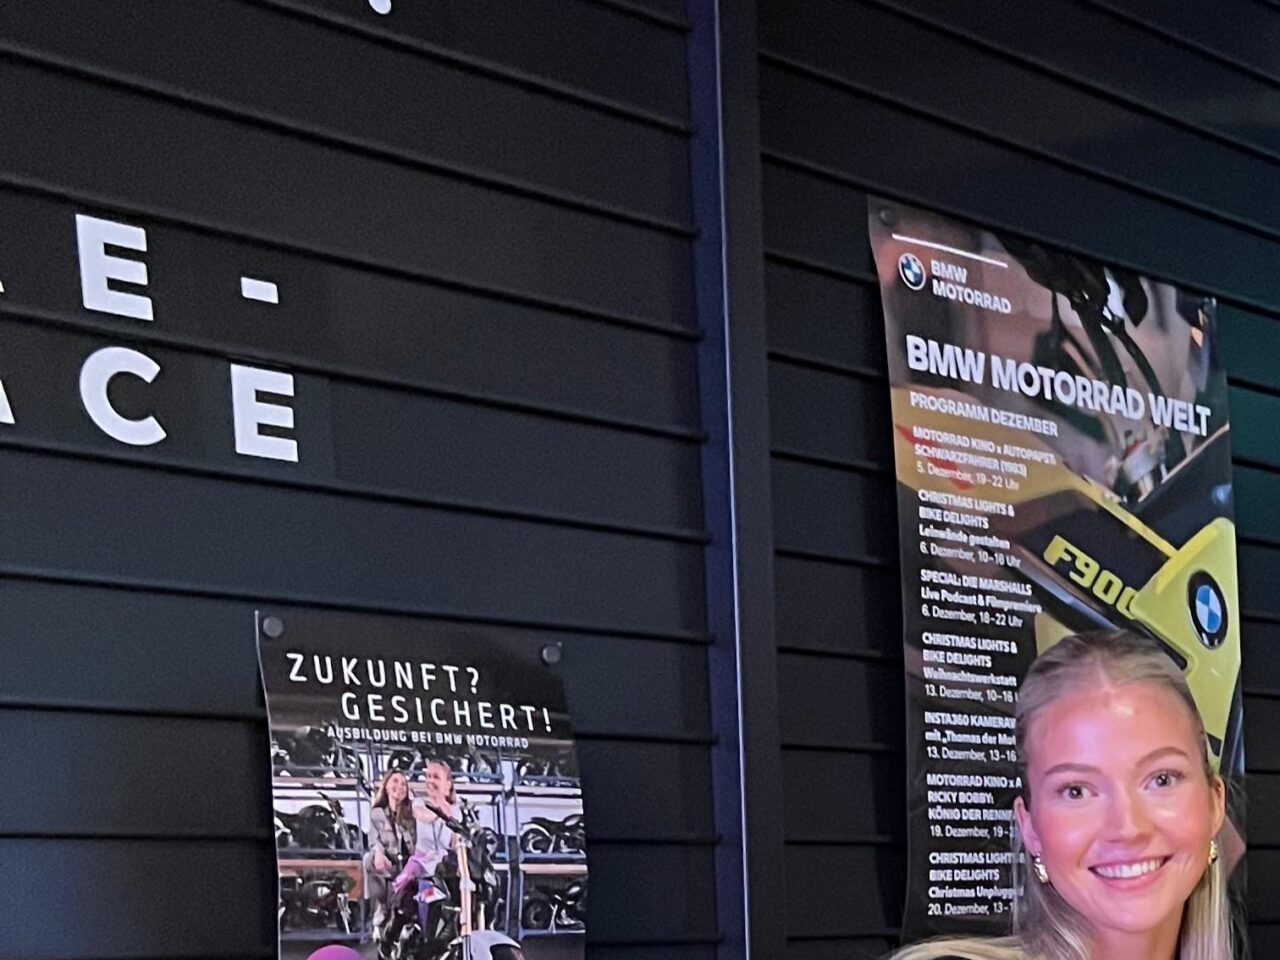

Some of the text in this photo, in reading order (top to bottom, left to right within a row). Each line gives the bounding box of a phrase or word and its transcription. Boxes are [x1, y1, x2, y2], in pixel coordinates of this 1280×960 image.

[931, 260, 967, 283] BMW
[932, 279, 1011, 313] MOTORRAD
[906, 335, 1211, 436] BMW MOTORRAD WELT
[910, 392, 1058, 437] PROGRAMM DEZEMBER
[913, 426, 969, 447] MOTORRAD
[971, 438, 995, 452] KINO
[917, 461, 926, 473] 5.
[928, 463, 973, 484] Dezember,
[1005, 477, 1019, 490] Uhr
[918, 489, 973, 508] CHRISTMAS
[975, 499, 1006, 515] LIGHTS
[919, 506, 989, 529] BIKE DELIGHTS
[919, 541, 929, 554] 6.
[931, 543, 975, 563] Dezember,
[1006, 555, 1021, 569] Uhr
[921, 569, 1032, 596] SPECIAL: DIE MARSHALLS
[921, 586, 939, 600] Live
[941, 589, 977, 606] Podcast
[922, 604, 931, 617] 6.
[932, 605, 977, 624] Dezember,
[1008, 616, 1023, 628] Uhr
[922, 632, 977, 649] CHRISTMAS
[978, 639, 1010, 653] LIGHTS
[923, 650, 992, 668] BIKE DELIGHTS
[286, 653, 479, 694] ZUKUNFT?
[925, 683, 938, 697] 13.
[940, 685, 984, 703] Dezember,
[341, 692, 552, 733] GESICHERT!
[925, 711, 969, 727] INSTA360
[327, 726, 529, 749] AUSBILDUNG BEI BMW MOTORRAD
[925, 729, 942, 741] mit
[982, 732, 997, 745] der
[927, 747, 940, 760] 13.
[942, 749, 987, 762] Dezember,
[927, 773, 982, 787] MOTORRAD
[984, 776, 1007, 788] KINO
[928, 791, 957, 804] RICKY
[928, 806, 960, 820] KÖNIG
[962, 809, 981, 821] DER
[930, 825, 944, 837] 19.
[945, 826, 991, 839] Dezember,
[929, 852, 984, 865] CHRISTMAS
[929, 869, 999, 881] BIKE DELIGHTS
[929, 886, 975, 899] Christmas
[928, 902, 943, 916] 20.
[944, 903, 989, 916] Dezember,
